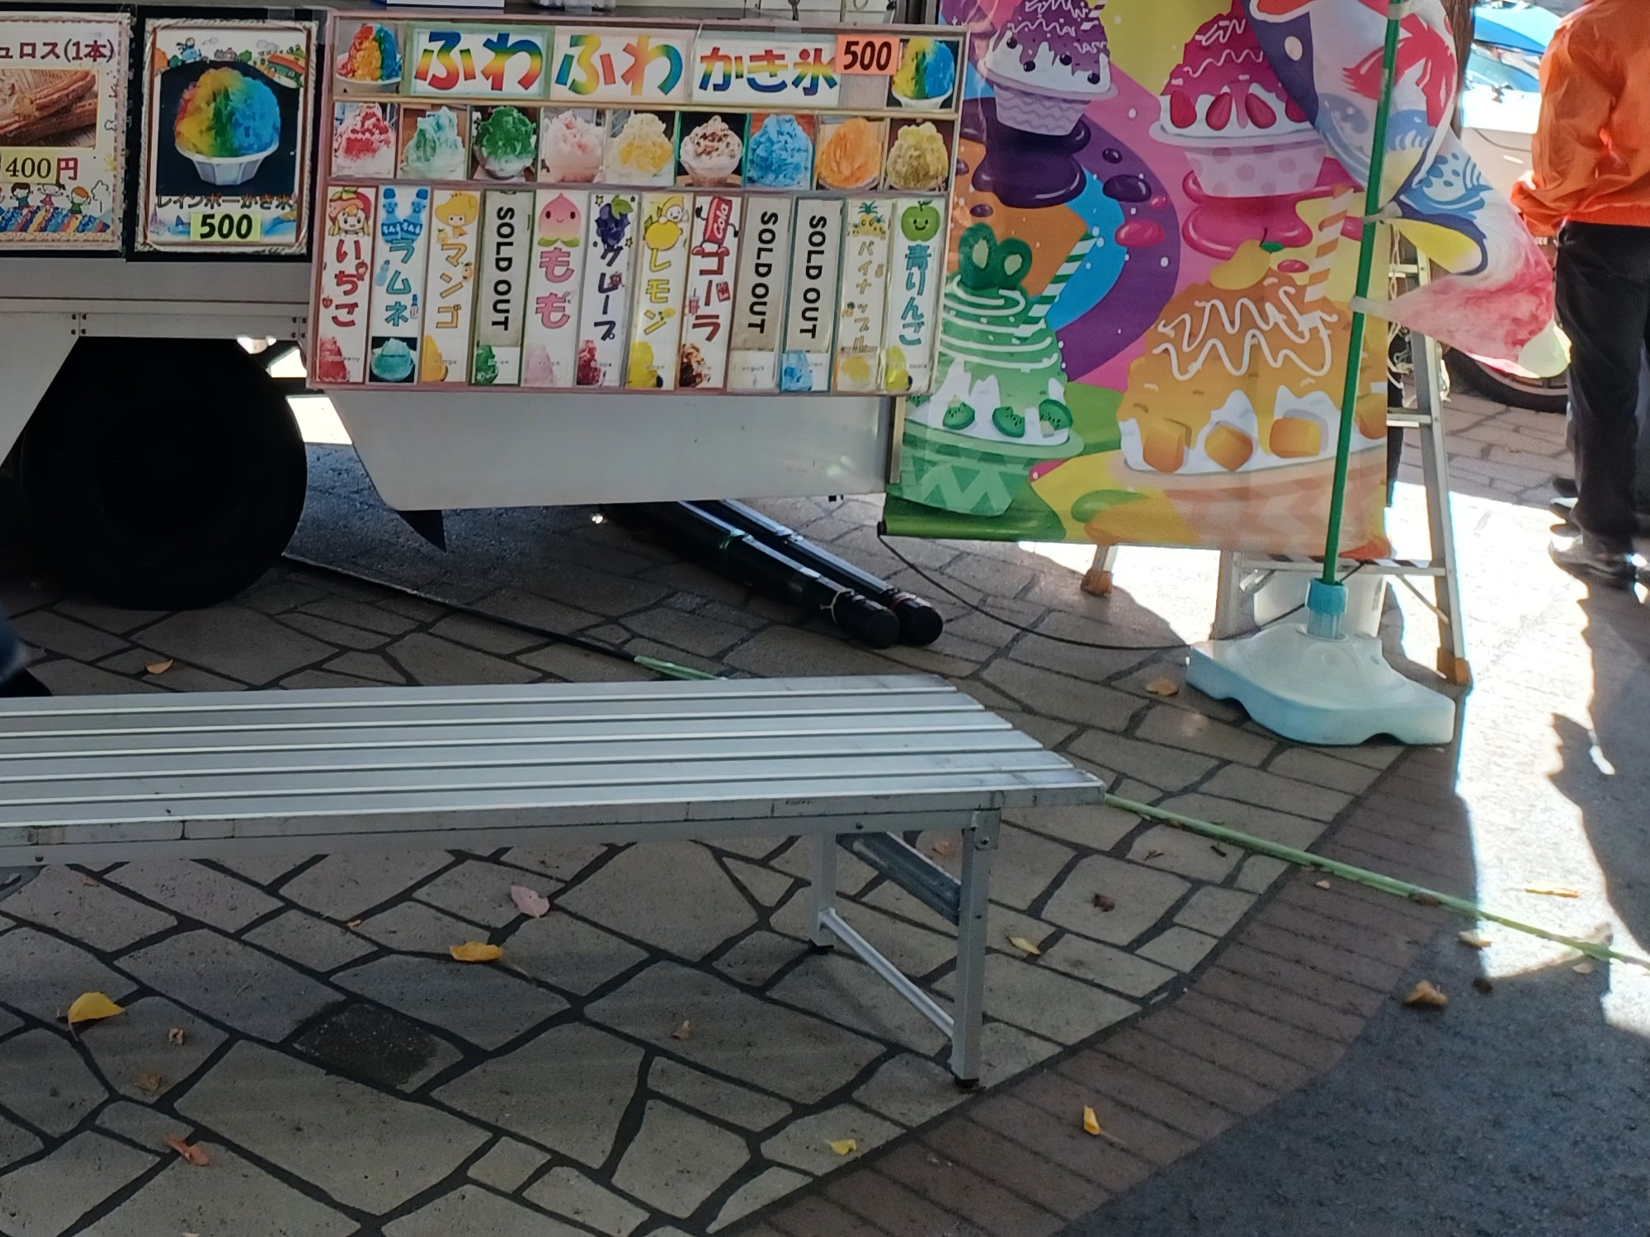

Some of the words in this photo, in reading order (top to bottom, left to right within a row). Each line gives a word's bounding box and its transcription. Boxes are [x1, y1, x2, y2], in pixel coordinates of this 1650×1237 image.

[698, 46, 838, 97] かき氷
[843, 40, 893, 72] 500
[156, 192, 294, 211] レインボーかき氷
[200, 213, 253, 240] 500
[713, 202, 729, 239] Cola
[495, 206, 516, 273] SOLD
[754, 211, 779, 278] SOLD
[805, 214, 827, 280] SOLD
[331, 238, 361, 328] いちご
[385, 237, 416, 328] ラムネ
[436, 242, 467, 329] マンゴ
[491, 283, 513, 332] OUT
[535, 246, 575, 330] もも
[644, 247, 672, 336] レモン
[692, 253, 725, 342] コーラ
[748, 282, 770, 334] OUT
[800, 286, 821, 339] OUT
[852, 240, 876, 352] パイナップル
[899, 244, 932, 347] 青りんご
